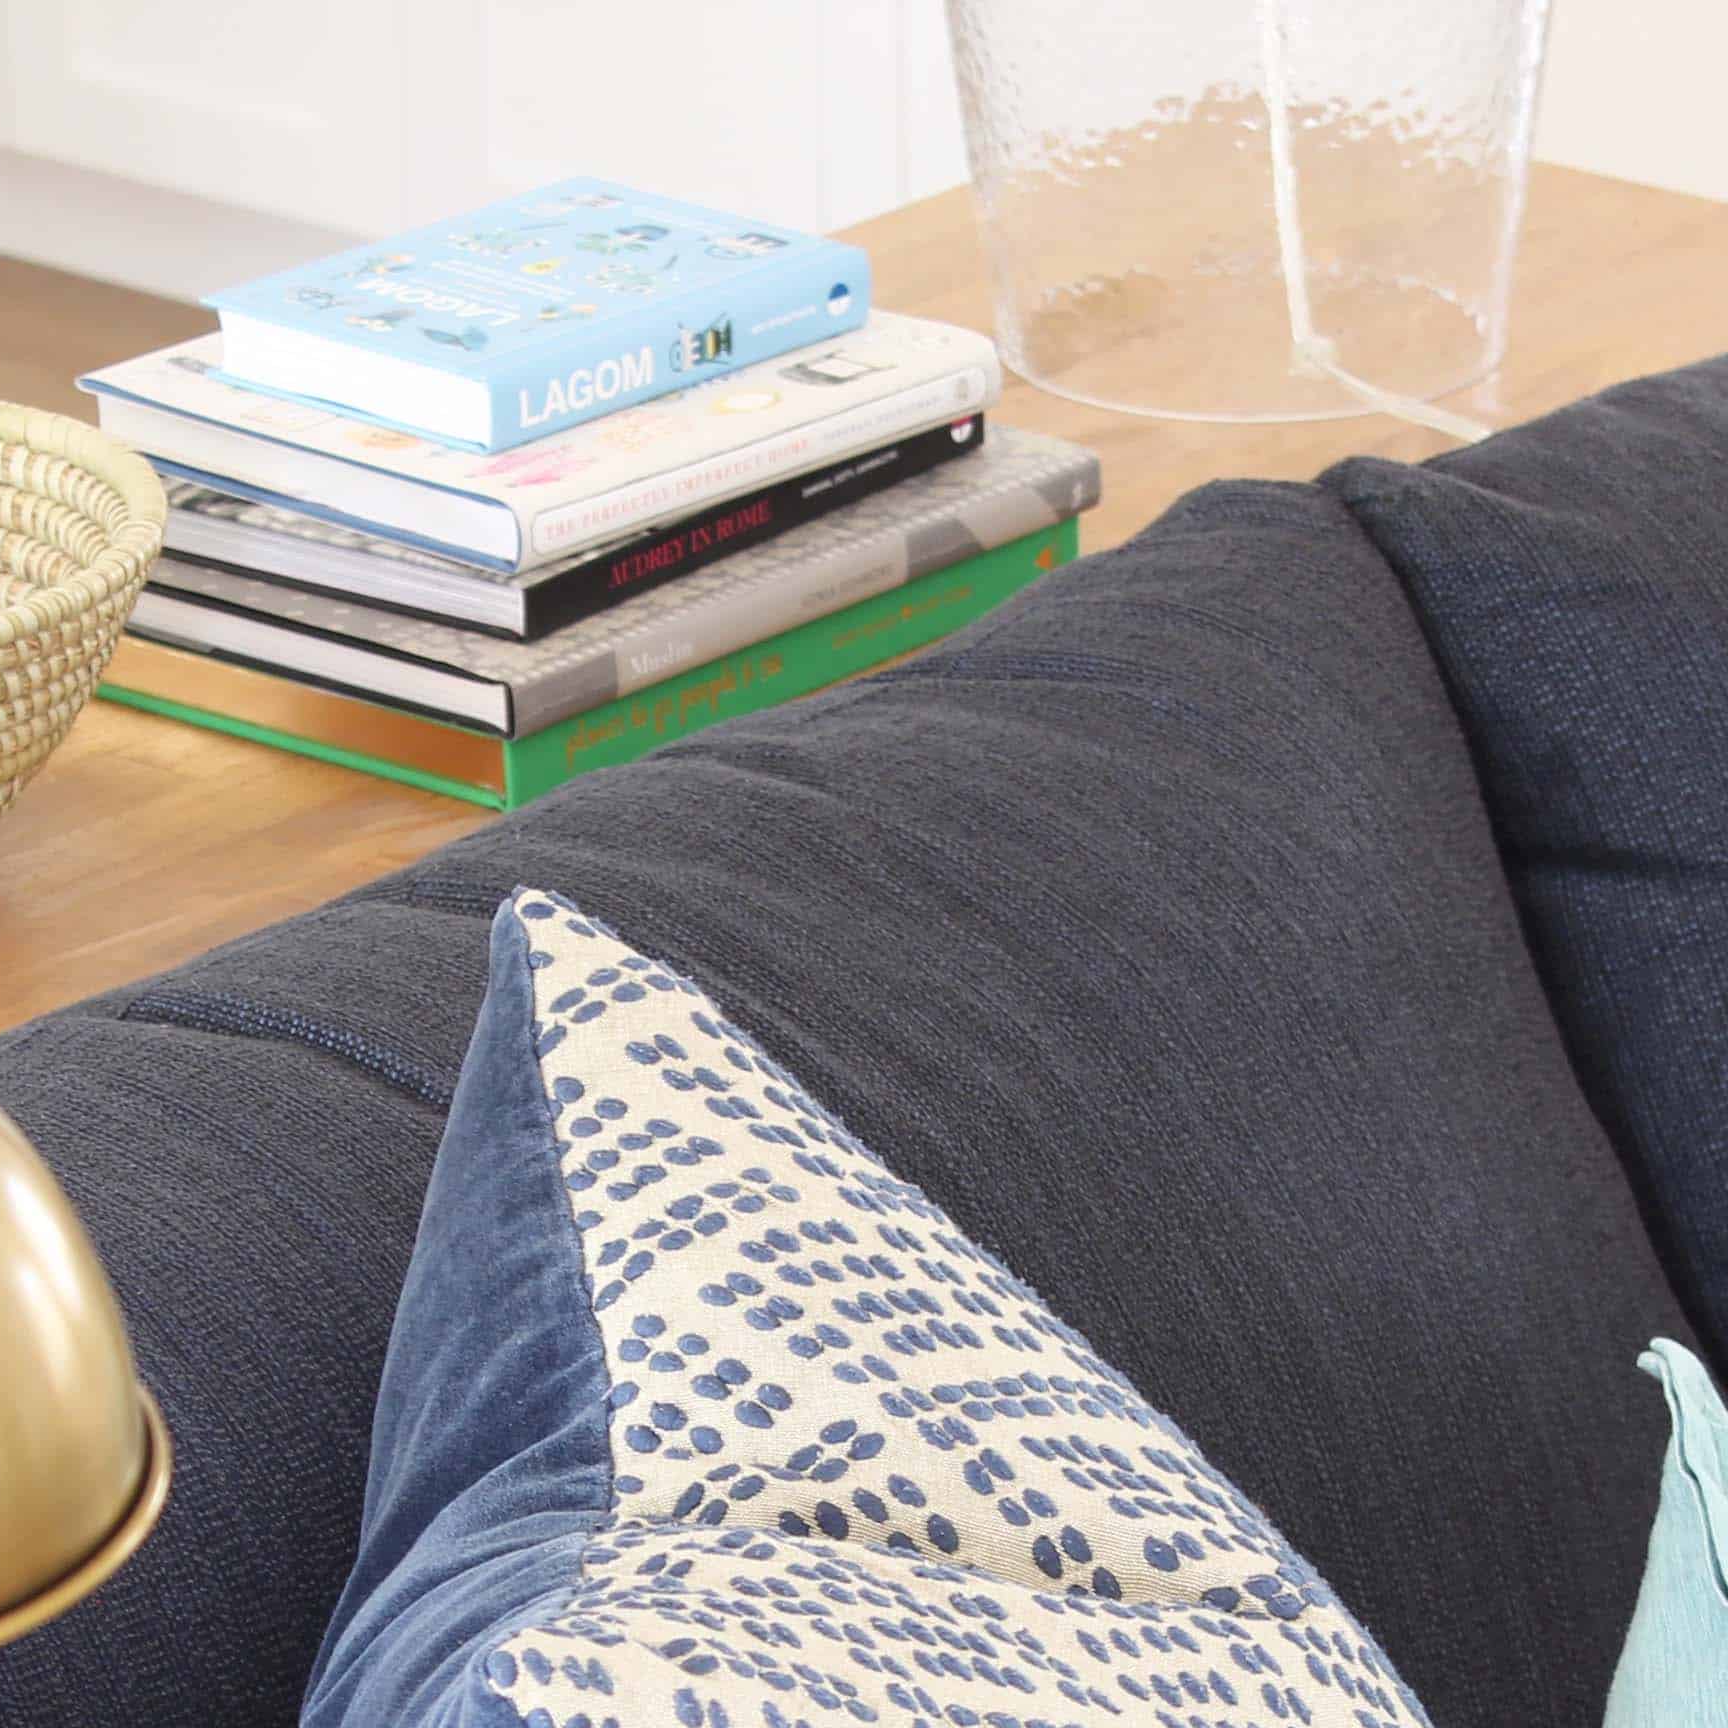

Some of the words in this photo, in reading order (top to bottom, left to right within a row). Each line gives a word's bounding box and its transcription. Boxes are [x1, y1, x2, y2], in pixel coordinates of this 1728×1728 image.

[355, 276, 521, 328] LAGOM
[518, 344, 655, 429] LAGOM
[608, 534, 685, 591] AUDREY
[689, 524, 714, 553] IN
[715, 499, 771, 542] ROME
